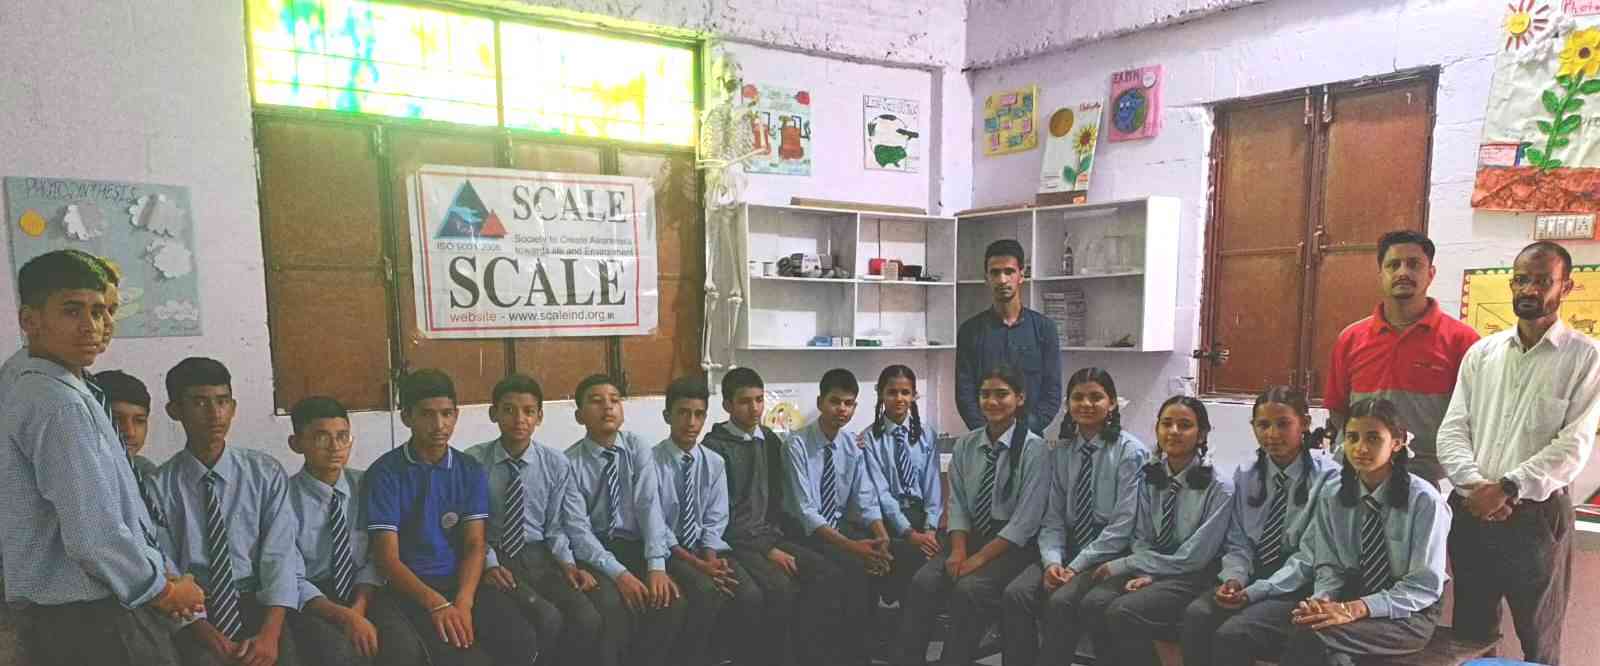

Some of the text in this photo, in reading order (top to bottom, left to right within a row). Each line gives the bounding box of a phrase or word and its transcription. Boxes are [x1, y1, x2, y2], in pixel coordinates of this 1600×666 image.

[512, 184, 628, 223] SCALE
[448, 255, 627, 309] SCALE
[449, 311, 497, 322] website
